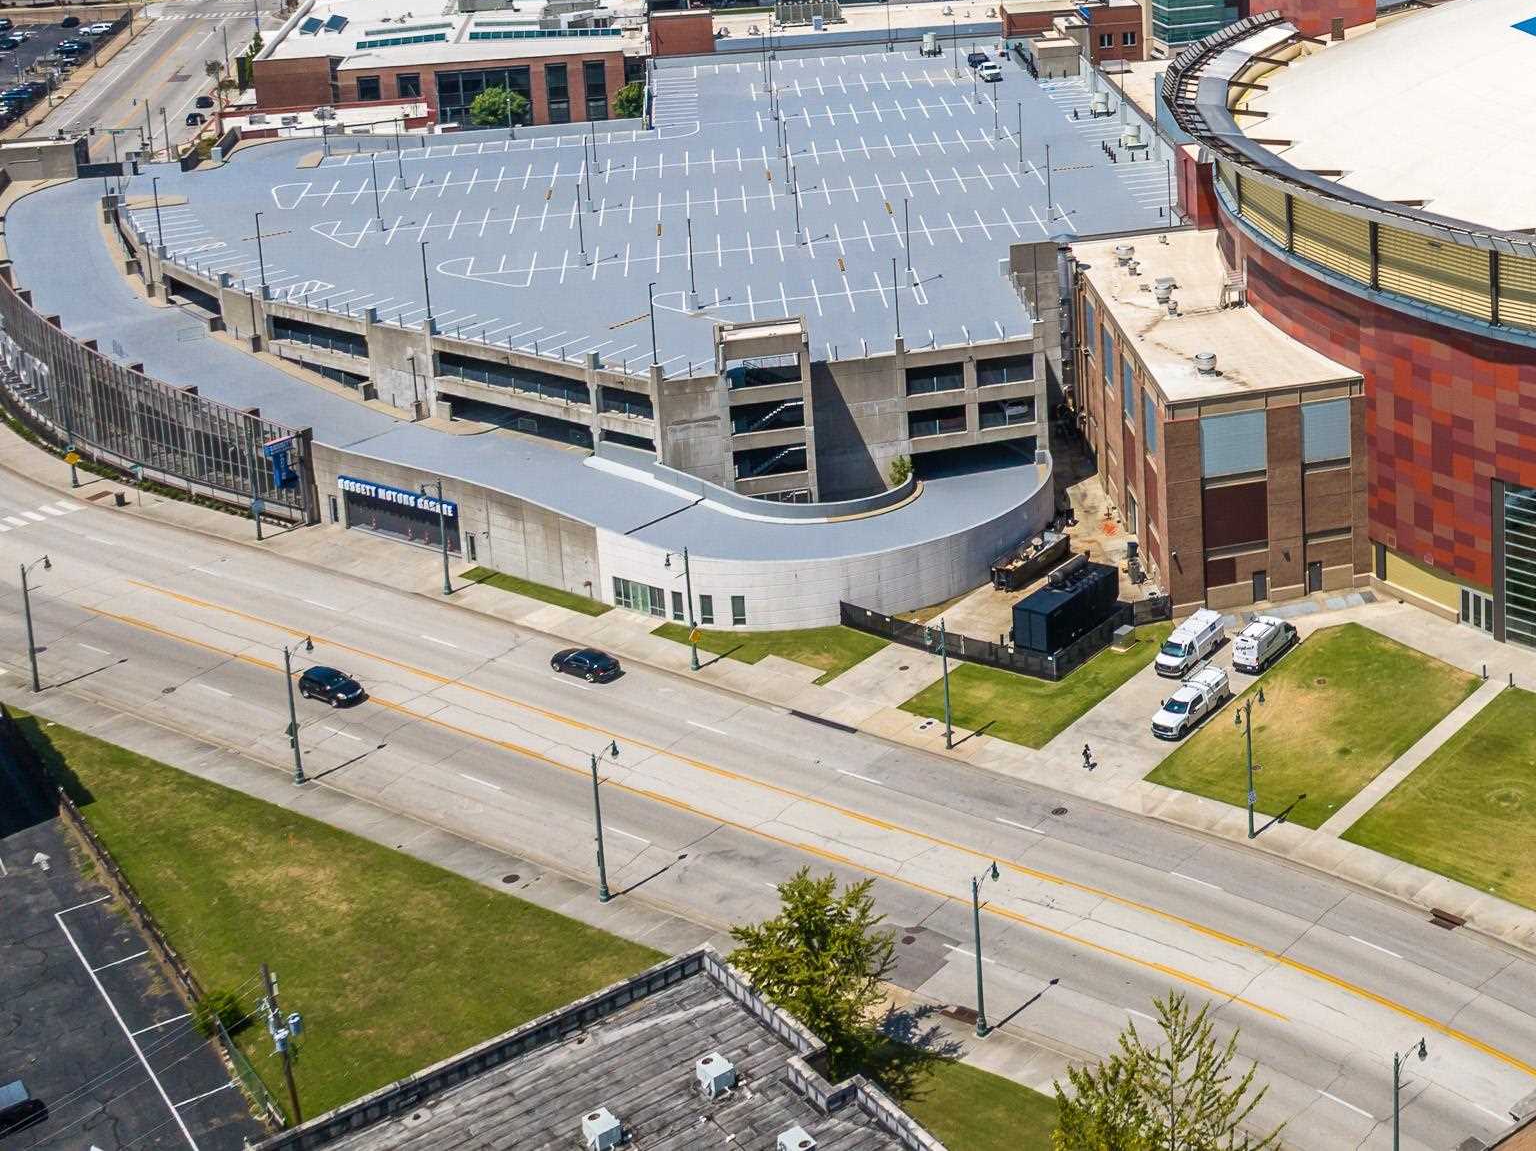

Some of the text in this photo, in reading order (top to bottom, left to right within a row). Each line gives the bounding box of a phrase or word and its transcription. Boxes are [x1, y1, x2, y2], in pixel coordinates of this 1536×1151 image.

[337, 478, 454, 517] GOSSETT MOTORS GARAGE
